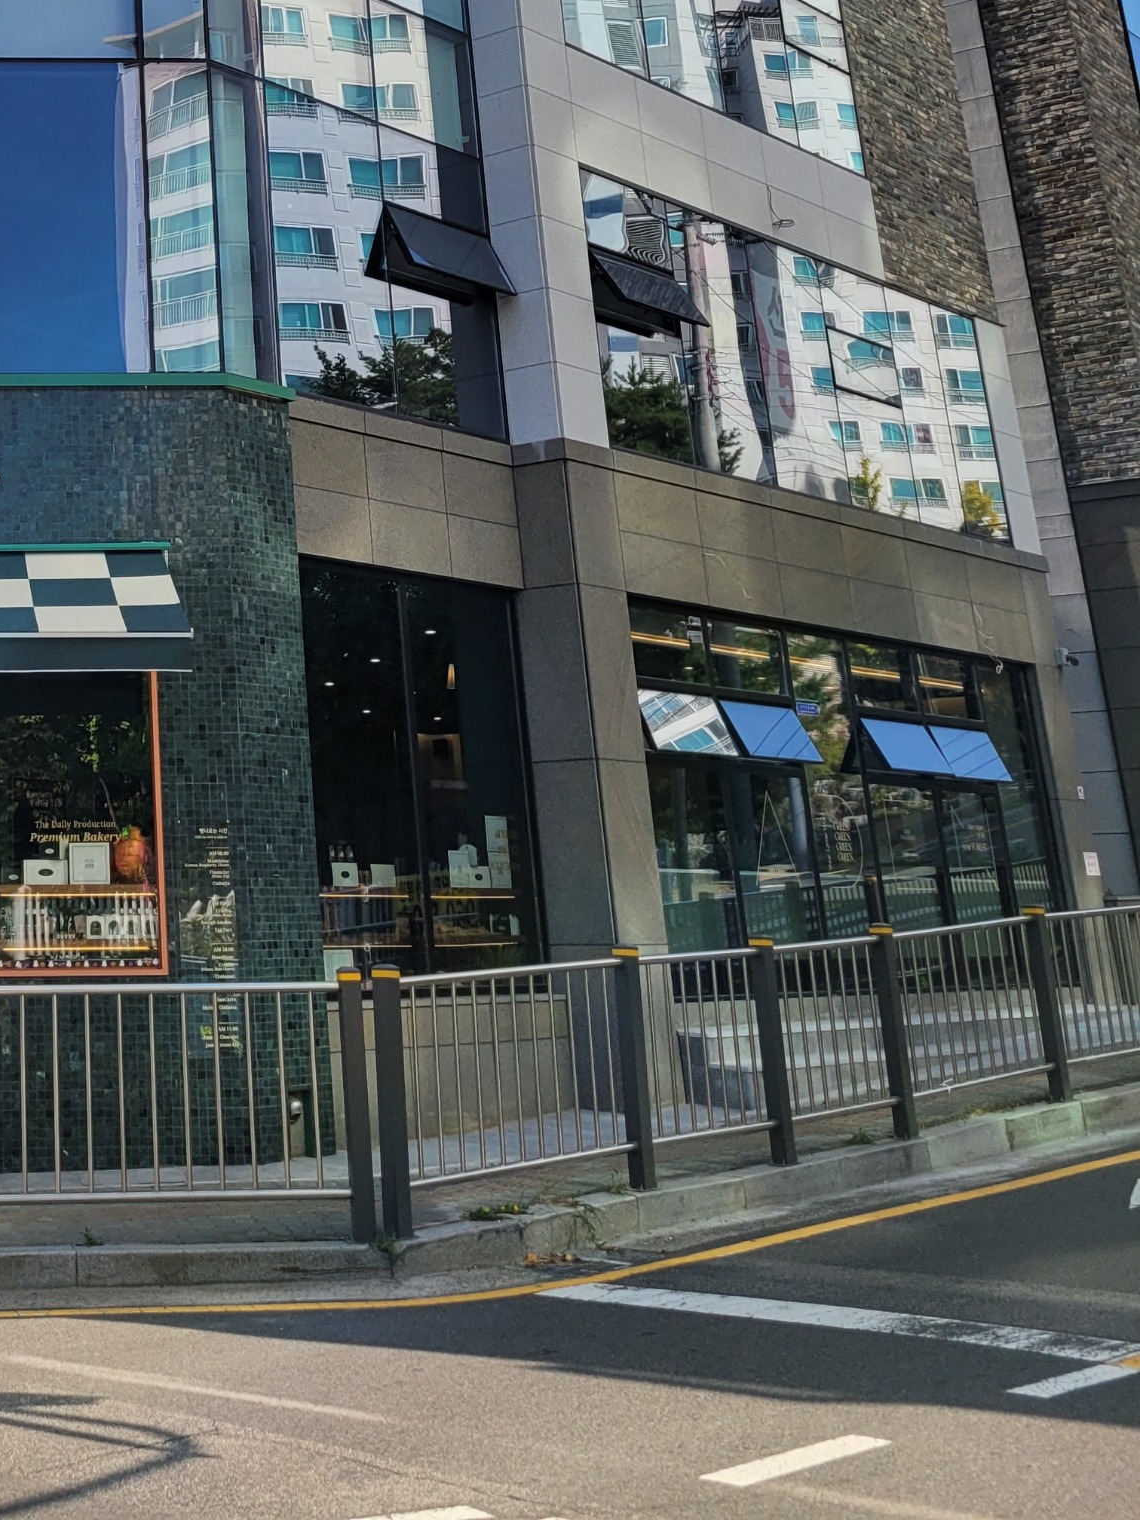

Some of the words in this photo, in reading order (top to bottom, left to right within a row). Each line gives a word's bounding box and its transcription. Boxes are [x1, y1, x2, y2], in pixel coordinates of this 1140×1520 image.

[35, 820, 50, 829] The
[51, 820, 72, 830] Daily
[73, 819, 116, 829] Production
[29, 832, 81, 843] Premium
[82, 832, 123, 845] Bakery
